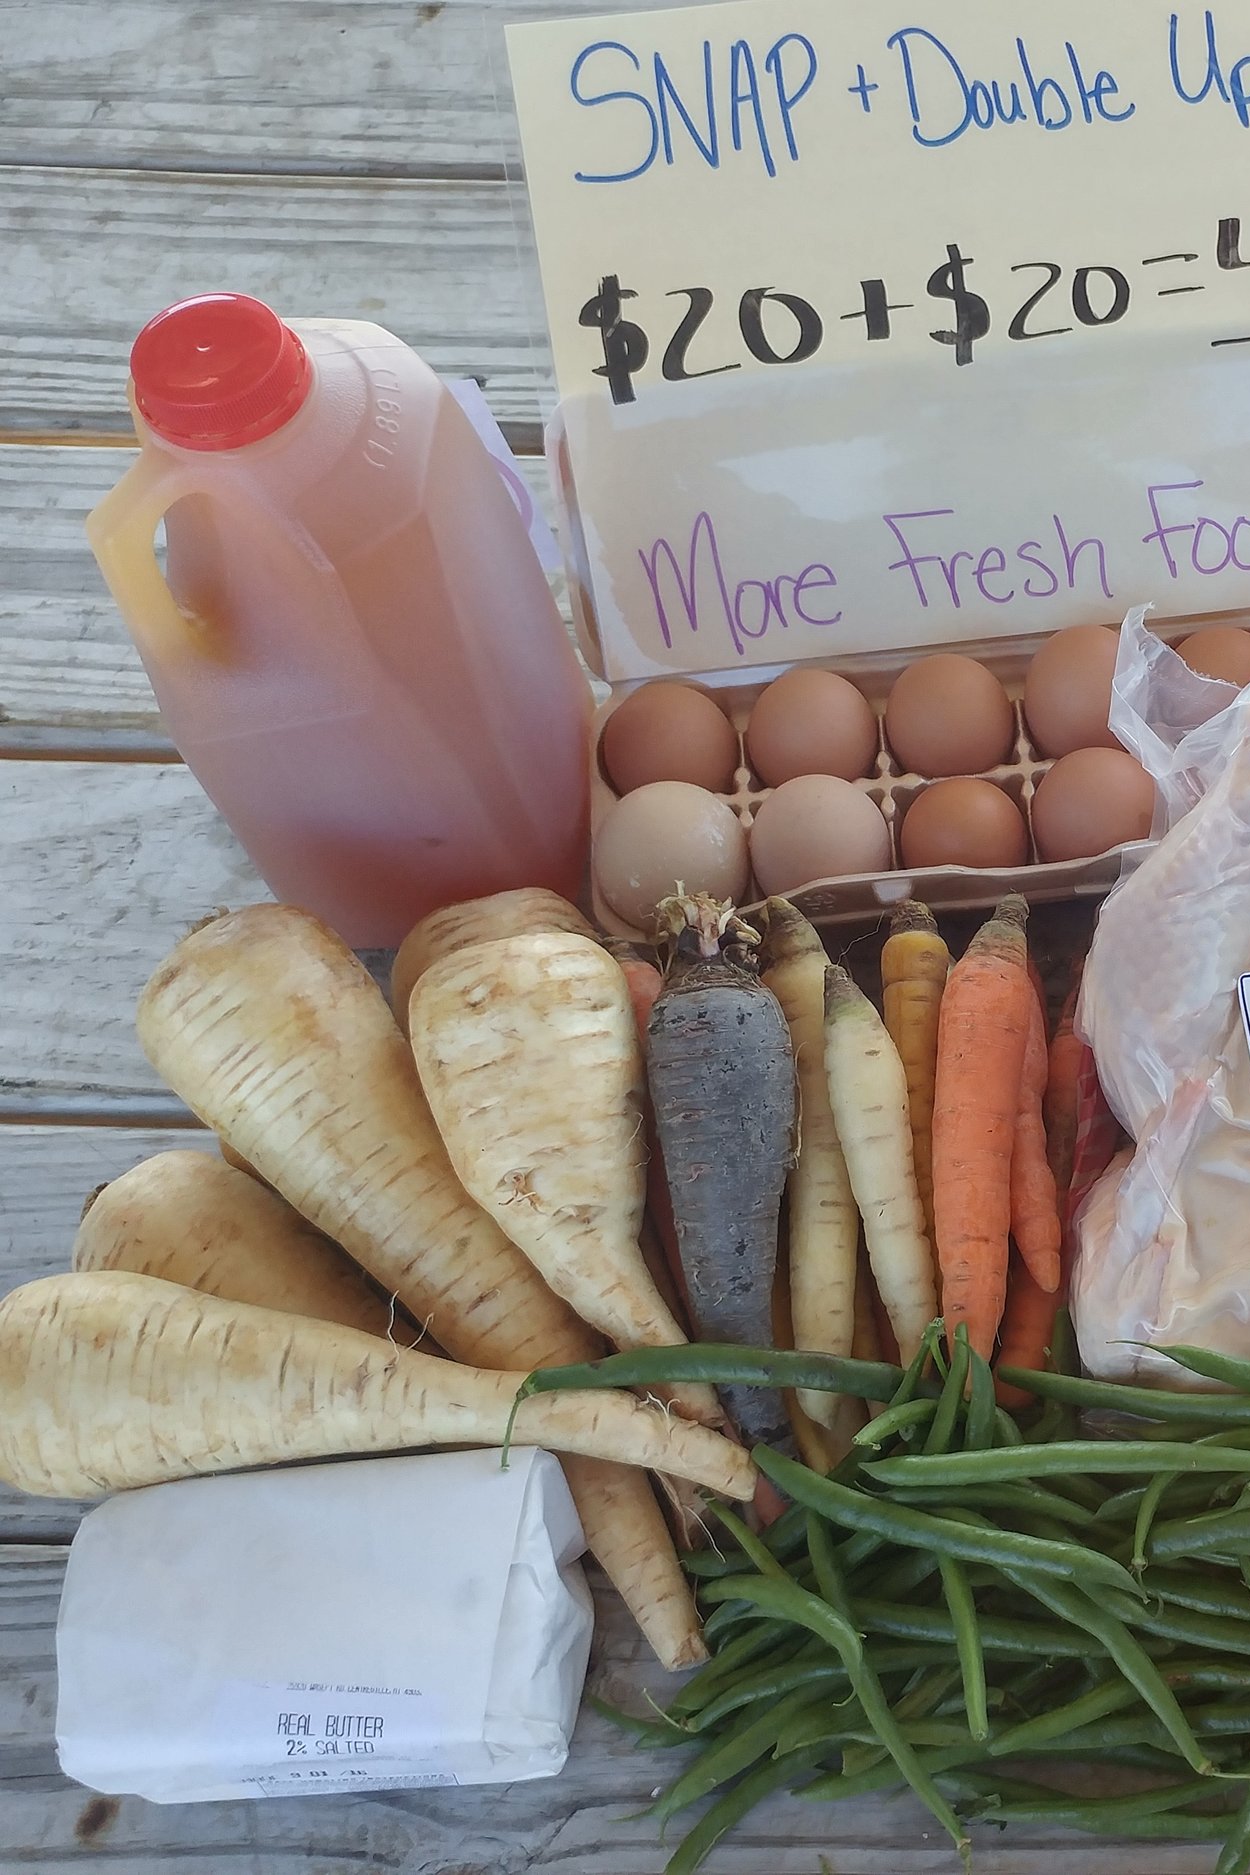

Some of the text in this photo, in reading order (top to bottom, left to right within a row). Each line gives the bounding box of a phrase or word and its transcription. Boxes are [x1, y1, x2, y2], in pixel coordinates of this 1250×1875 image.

[571, 31, 818, 183] SNAP
[848, 64, 880, 115] +
[886, 26, 1135, 148] Double
[637, 509, 842, 655] More
[882, 508, 1115, 611] Fresh
[277, 1713, 384, 1738] REAL BUTTER
[286, 1739, 375, 1756] 2% SALTED
